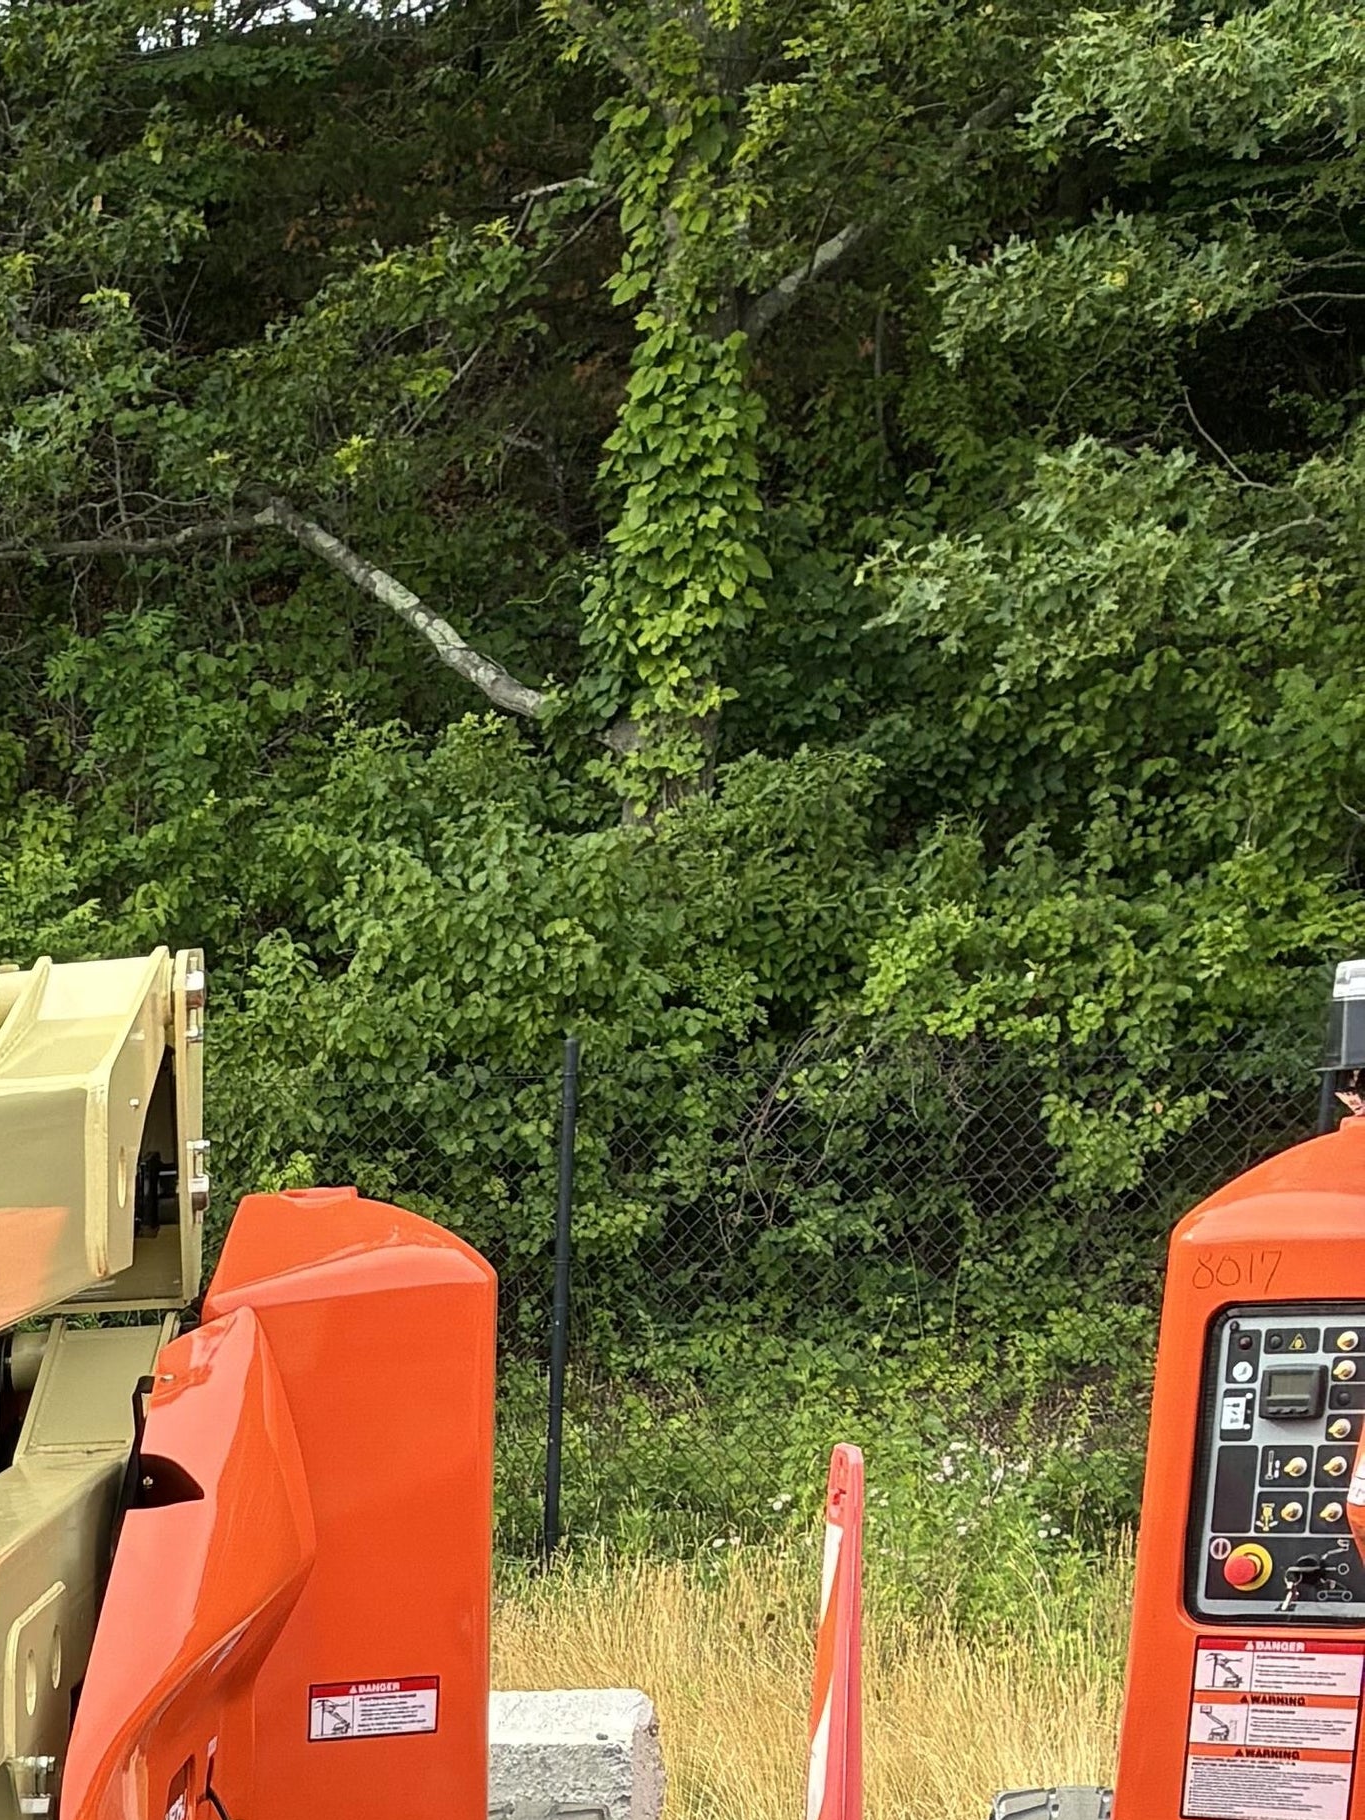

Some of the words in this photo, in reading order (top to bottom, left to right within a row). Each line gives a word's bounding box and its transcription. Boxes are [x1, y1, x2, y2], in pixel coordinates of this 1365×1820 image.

[1192, 1251, 1282, 1293] 8017
[1255, 1641, 1305, 1652] DANGER
[358, 1682, 400, 1694] DANGER
[1251, 1694, 1306, 1706] WARNING
[1245, 1748, 1300, 1760] WARNING
